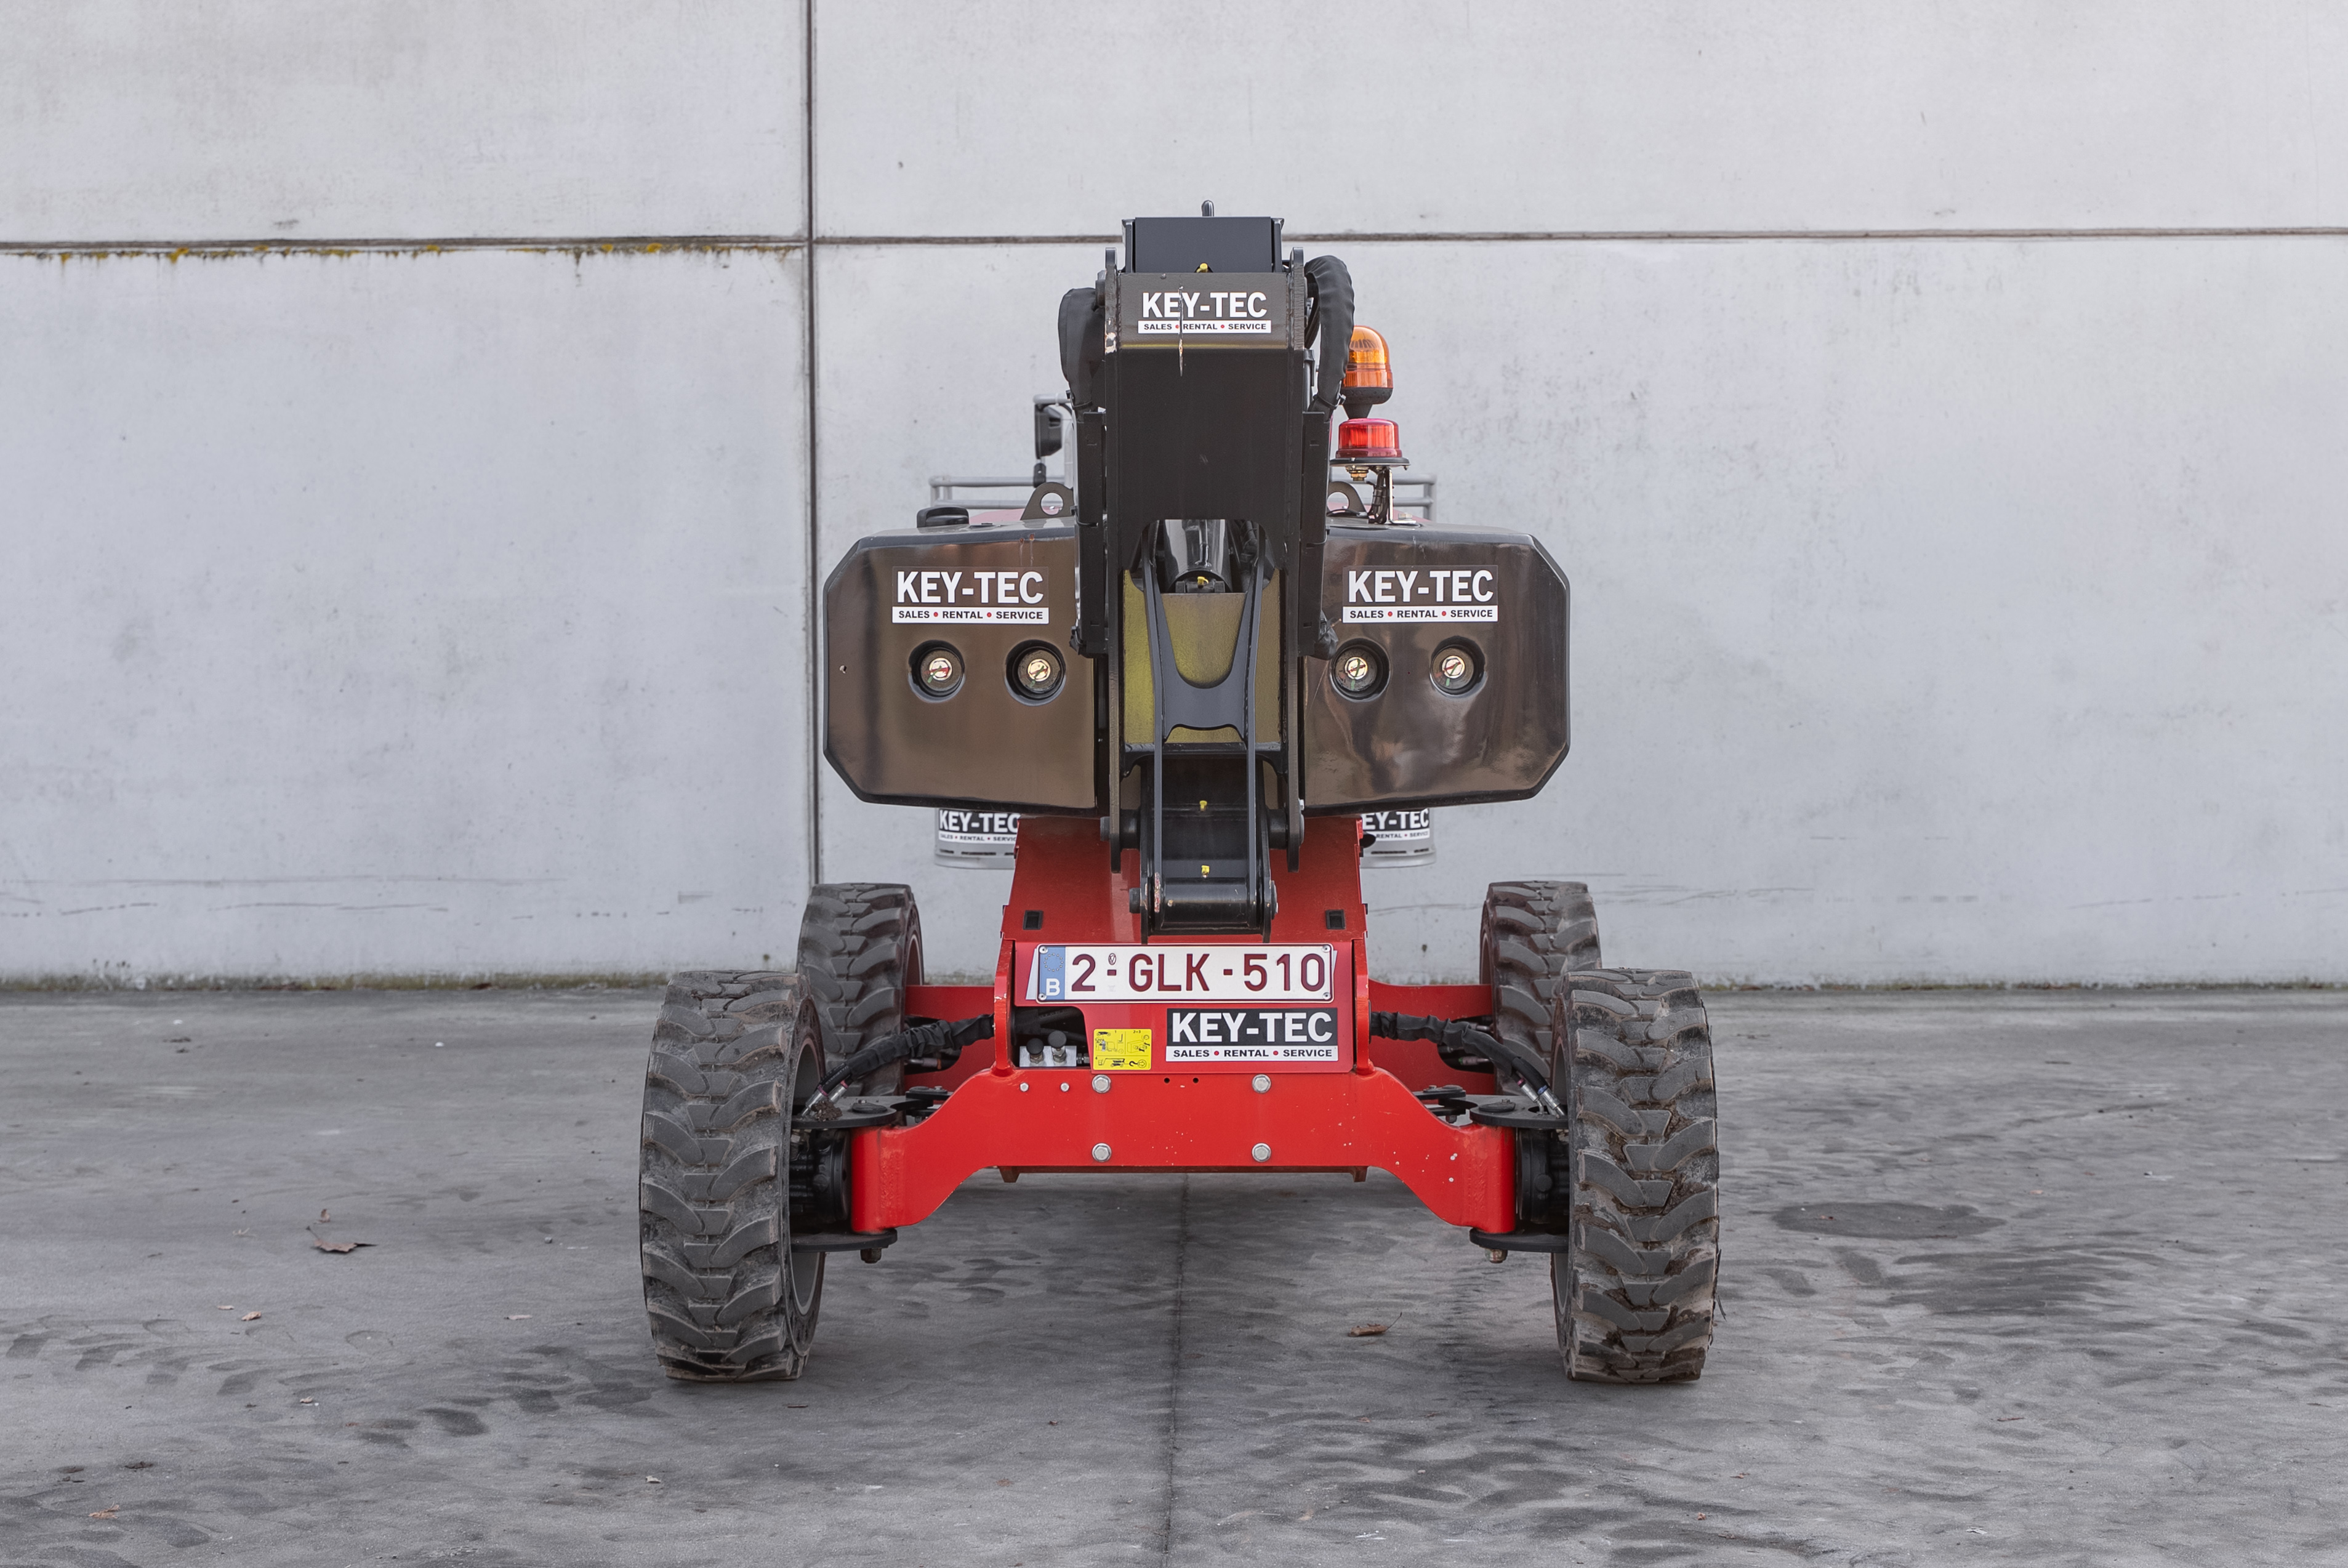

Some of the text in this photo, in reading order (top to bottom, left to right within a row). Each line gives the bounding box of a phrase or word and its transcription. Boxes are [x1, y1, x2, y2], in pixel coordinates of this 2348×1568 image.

[1143, 291, 1268, 318] KEY-TEC
[897, 571, 1044, 604] KEY-TEC
[1348, 569, 1494, 603] KEY-TEC
[898, 610, 1043, 619] SALES RENTAL SERVICE
[1349, 609, 1493, 619] SALES RENTAL SERVICE
[1361, 808, 1429, 830] EY-TEC
[1046, 978, 1060, 996] B
[1172, 1011, 1333, 1043] KEY-TEC
[1173, 1050, 1210, 1058] SALES
[1283, 1049, 1332, 1057] SERVICE
